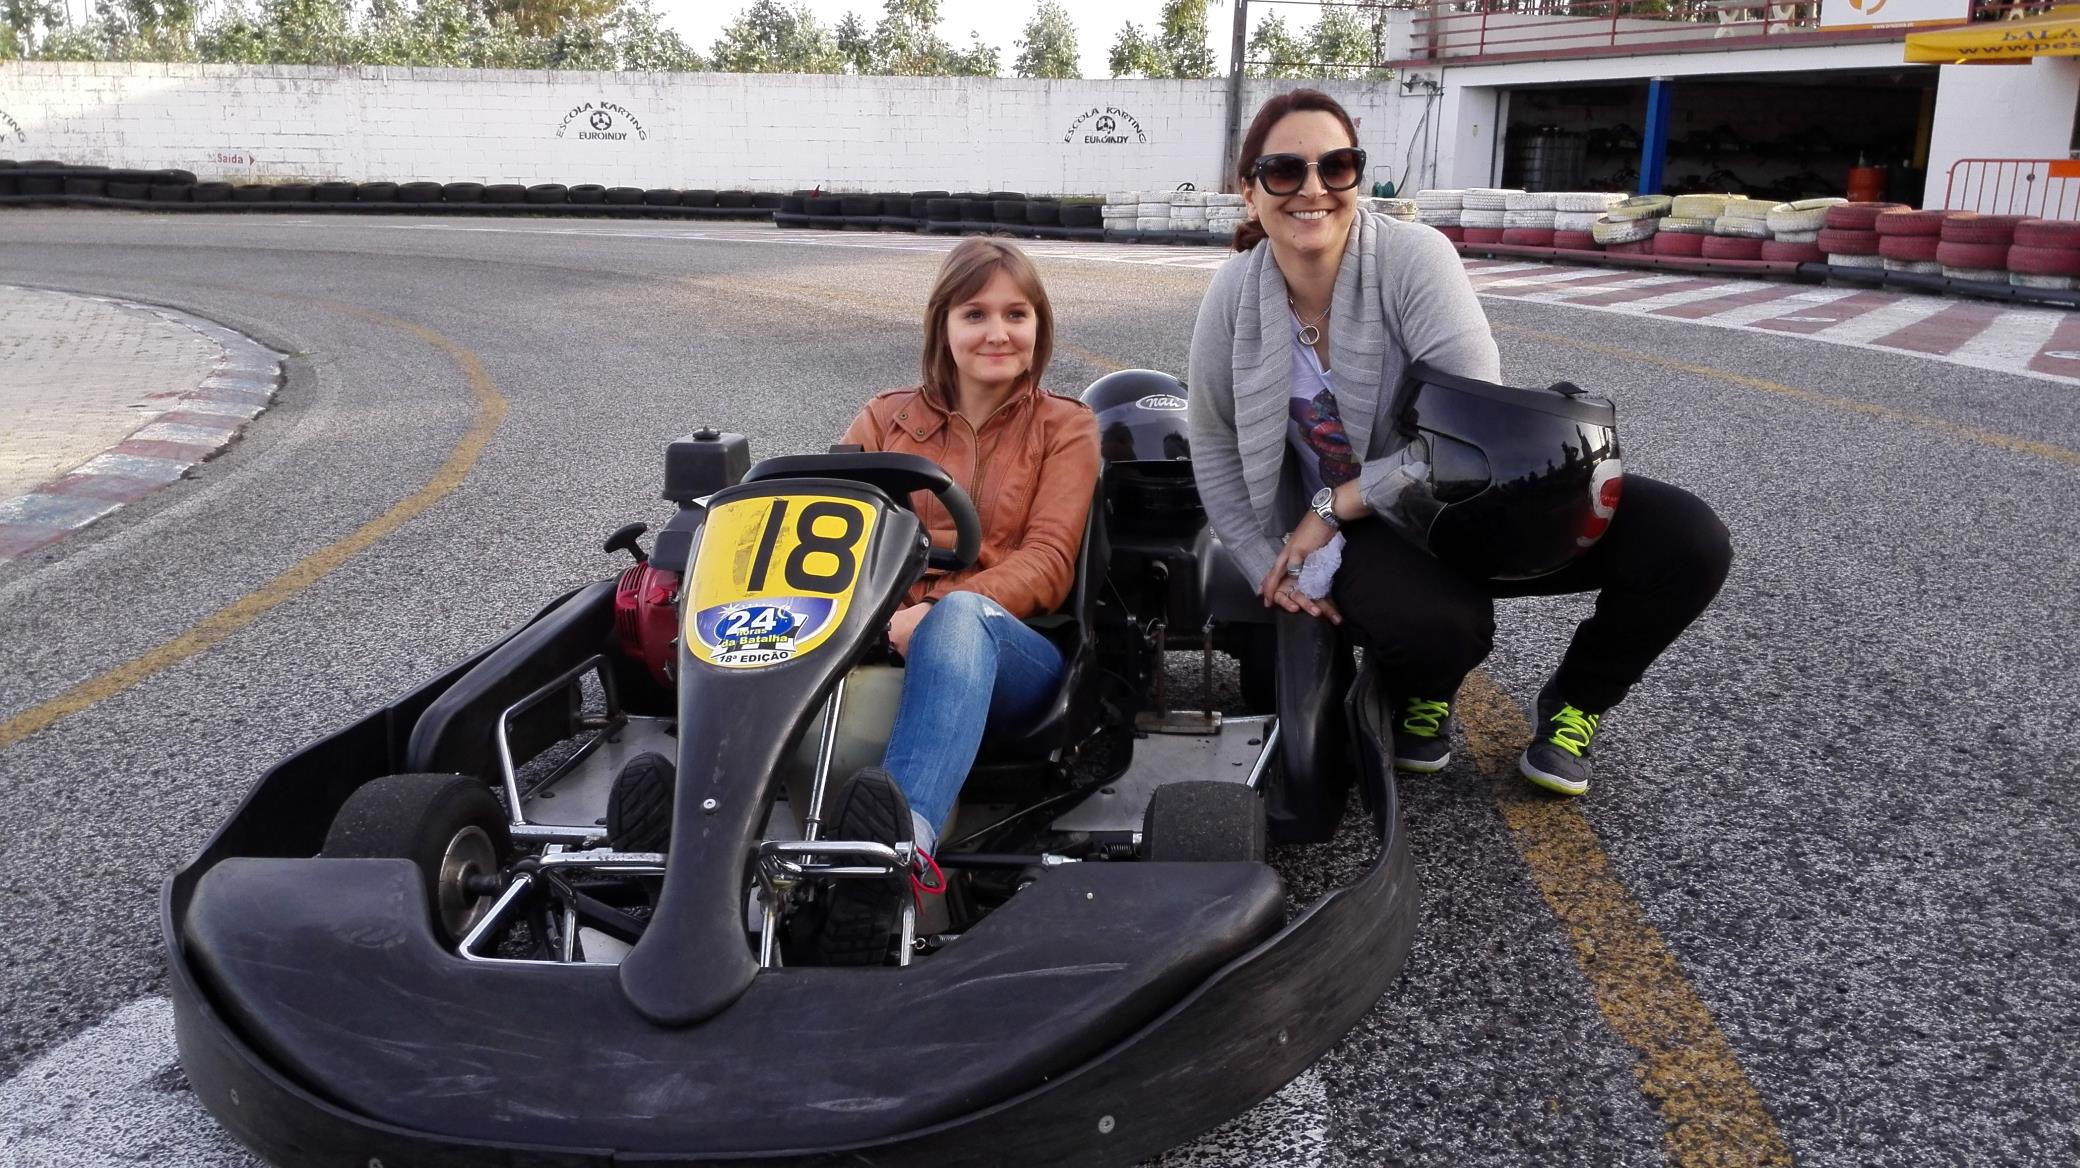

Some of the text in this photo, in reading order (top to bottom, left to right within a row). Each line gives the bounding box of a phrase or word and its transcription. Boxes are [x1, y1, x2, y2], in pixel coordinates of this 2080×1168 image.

[556, 101, 647, 140] ESCOLA KARTING
[1064, 106, 1146, 143] ESCOLA KARTING
[579, 131, 627, 140] EUROINDY
[747, 500, 865, 594] 18
[726, 608, 777, 636] 24
[721, 634, 788, 648] da Batalha
[740, 651, 789, 663] EDIÇÃO
